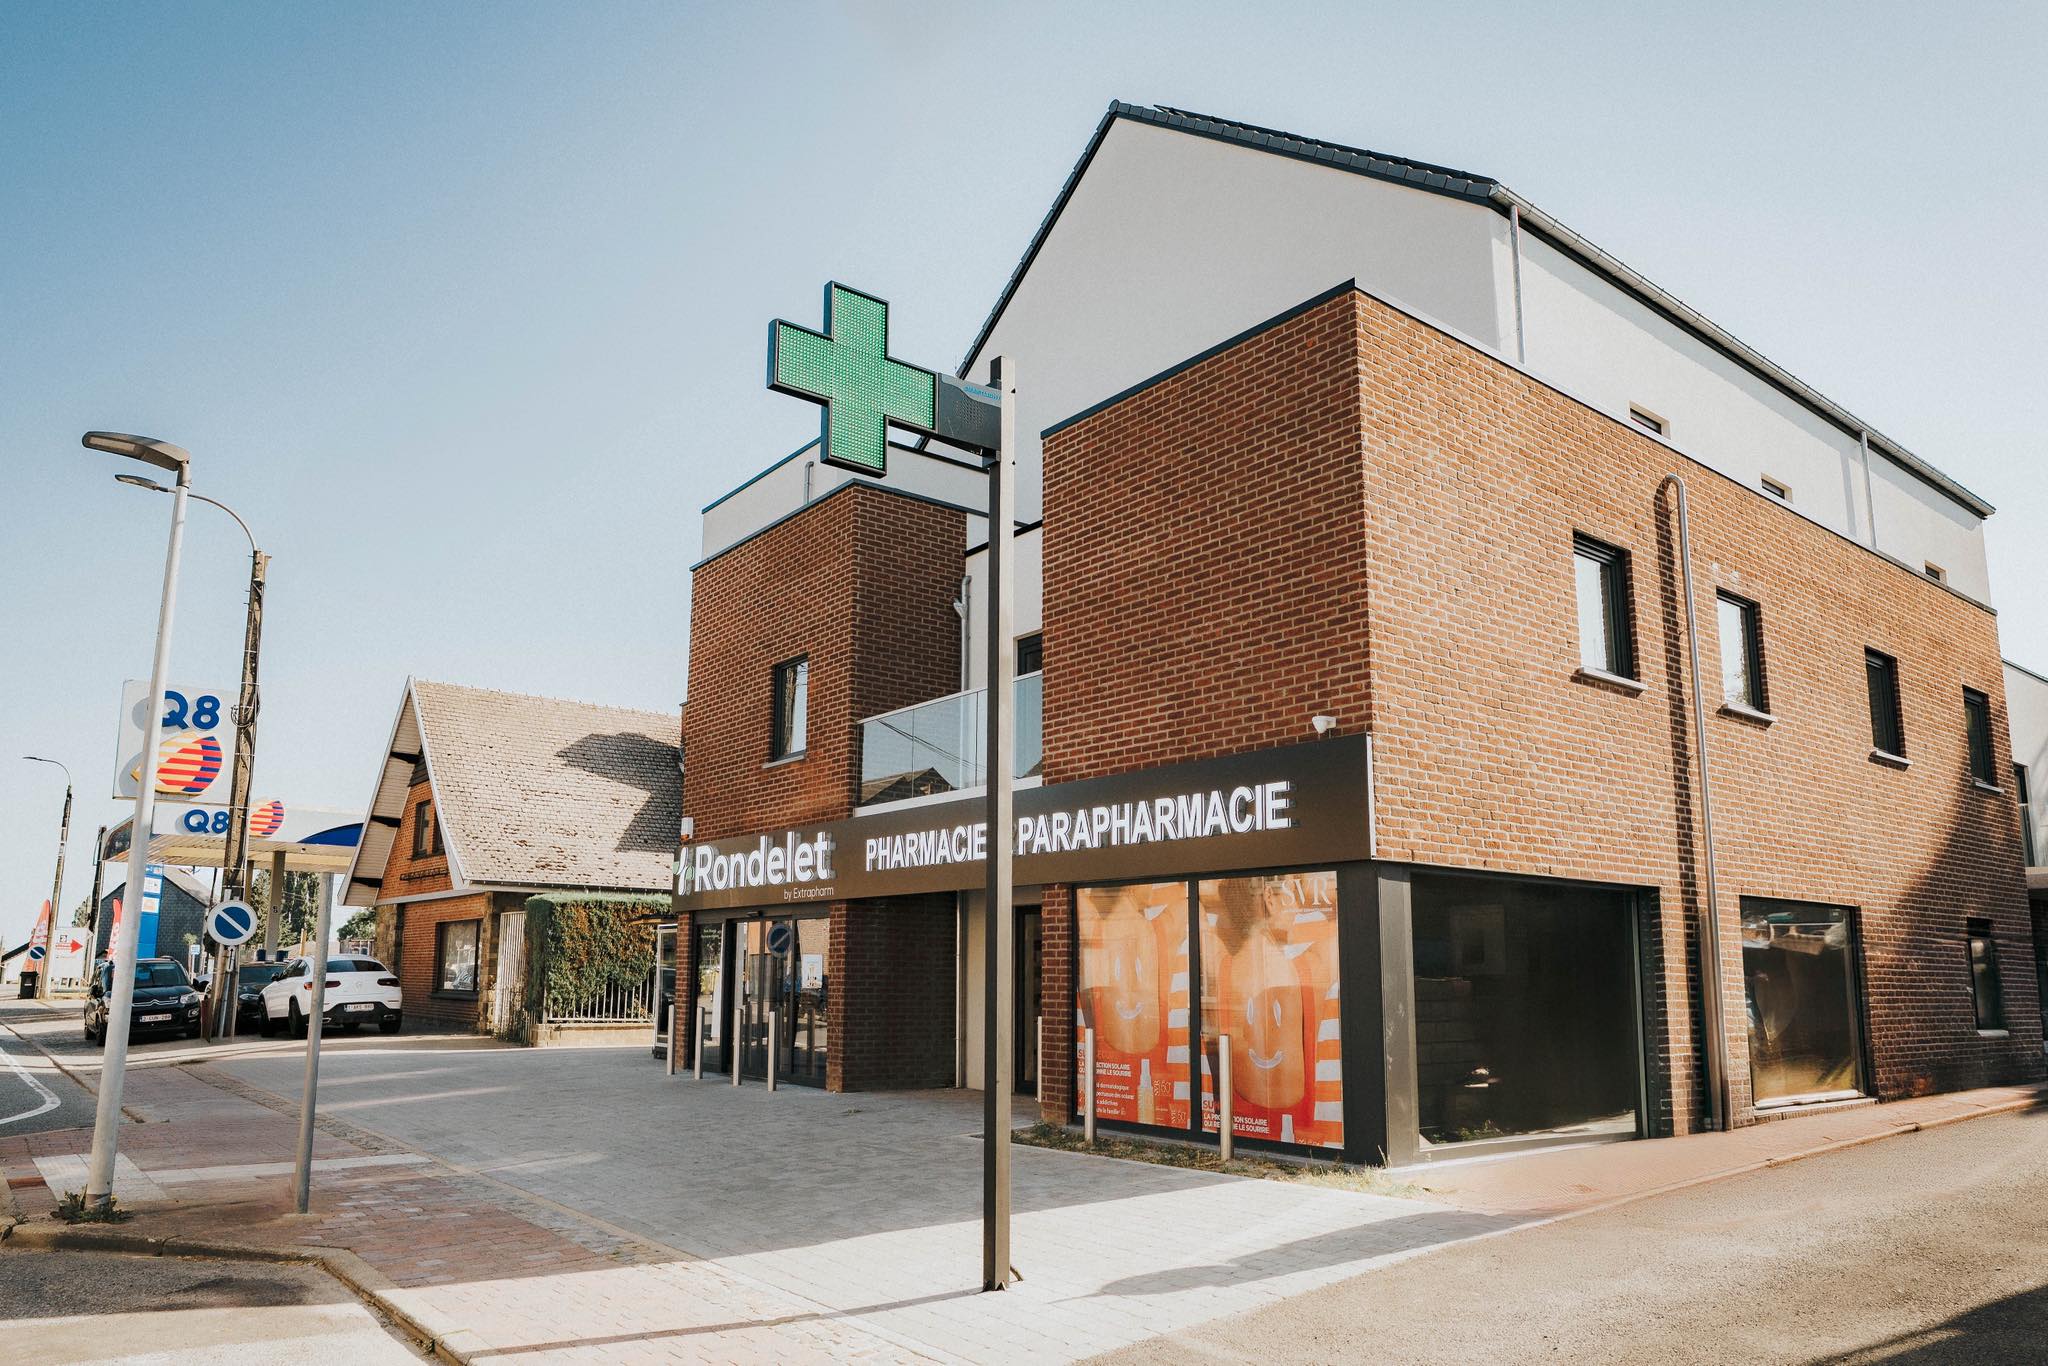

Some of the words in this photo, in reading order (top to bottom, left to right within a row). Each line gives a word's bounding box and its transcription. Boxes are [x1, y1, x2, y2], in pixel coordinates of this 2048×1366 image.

[162, 690, 221, 730] Q8
[184, 809, 230, 834] Q8
[866, 822, 987, 871] PHARMACIE
[1018, 781, 1291, 856] PARAPHARMACIE
[694, 831, 831, 892] Rondelet
[784, 888, 792, 901] by
[793, 886, 834, 900] Extrapharm
[1281, 878, 1333, 906] SVR
[1204, 1112, 1211, 1120] LA
[1245, 1117, 1268, 1126] SOLAIRE
[1246, 1124, 1269, 1134] SOURIRE
